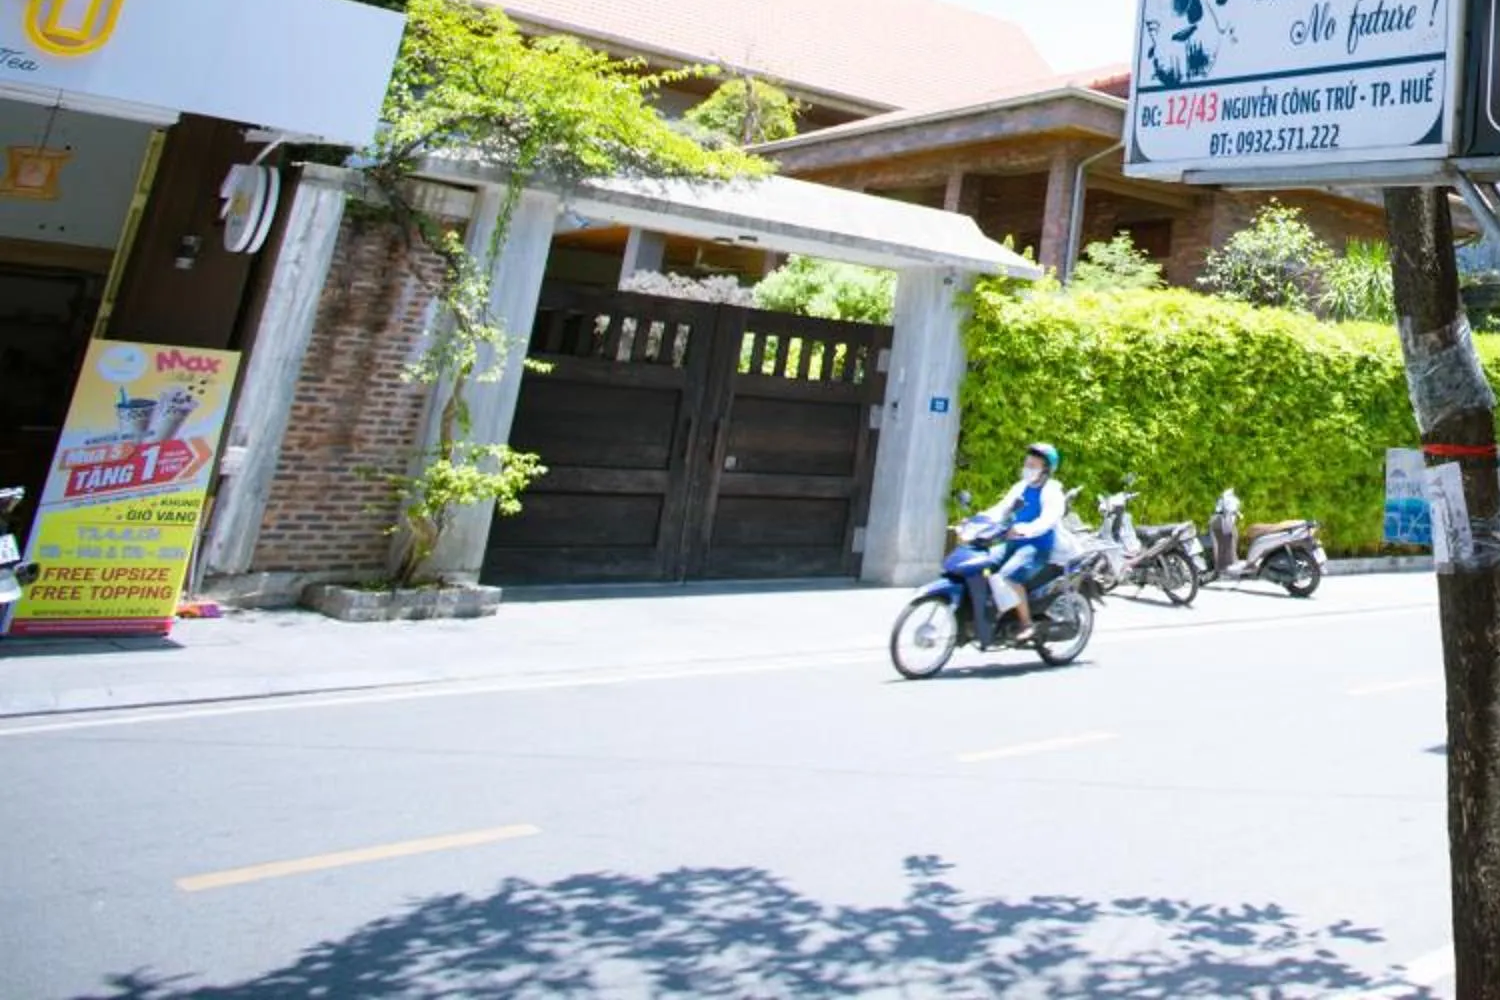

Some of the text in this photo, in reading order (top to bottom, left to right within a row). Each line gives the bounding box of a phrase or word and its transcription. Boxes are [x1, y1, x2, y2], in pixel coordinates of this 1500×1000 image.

[1290, 2, 1336, 45] No
[1165, 91, 1219, 130] 12/43
[1281, 86, 1321, 116] CÔNG
[1370, 82, 1395, 107] TP.
[1400, 68, 1437, 105] HUẾ
[1210, 124, 1340, 156] ĐT: 0932.571.222
[156, 349, 222, 374] Max
[141, 445, 161, 481] 1
[43, 566, 172, 582] FREE UPSIZE
[30, 584, 175, 601] FREE TOPPING
